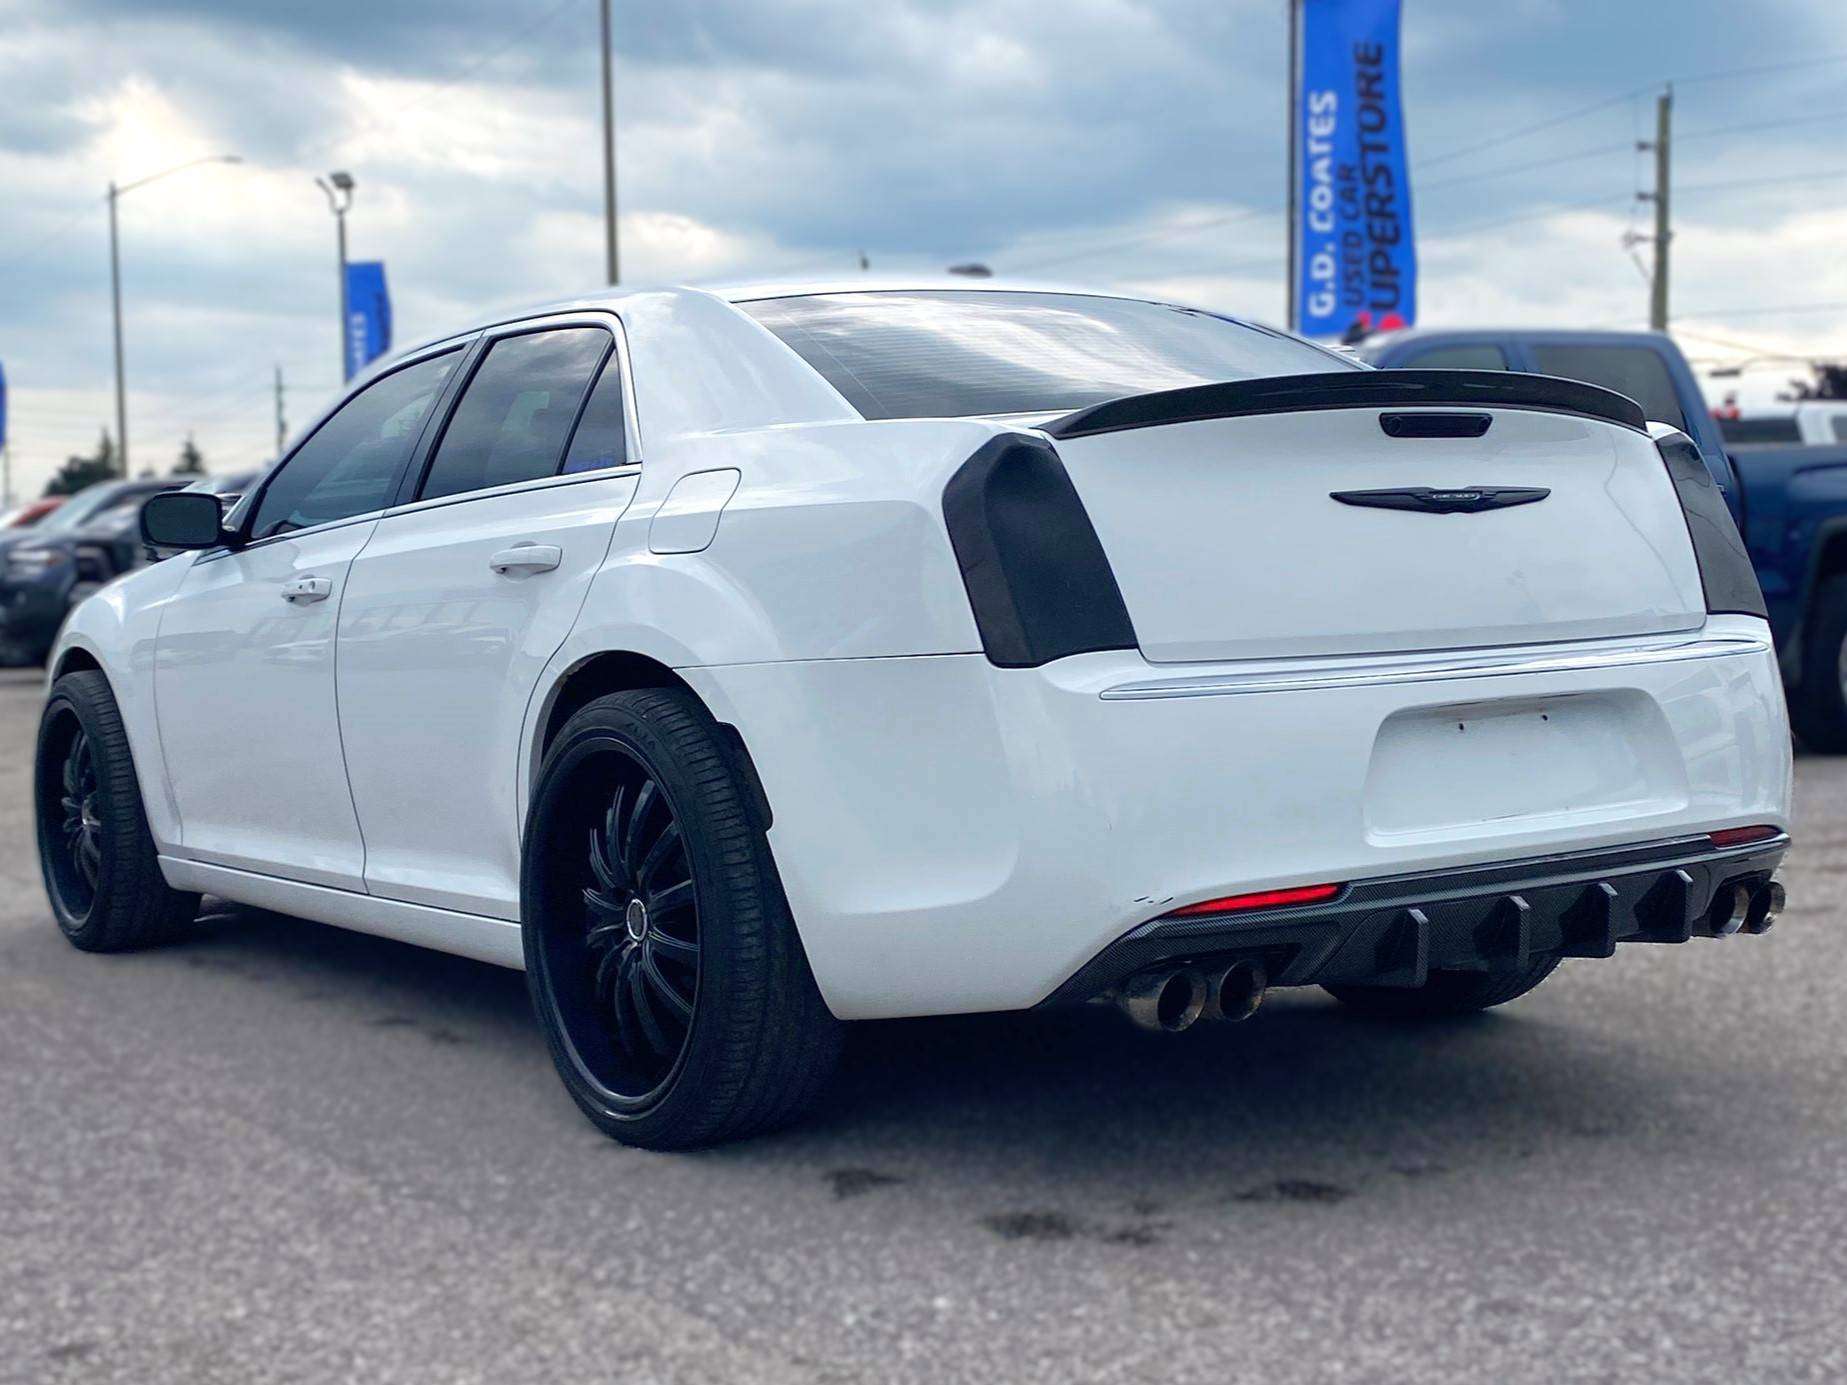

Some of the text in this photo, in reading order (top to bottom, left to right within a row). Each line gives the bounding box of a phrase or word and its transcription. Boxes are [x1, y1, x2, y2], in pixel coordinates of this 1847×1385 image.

[1307, 89, 1338, 318] G.D. COATES
[1337, 163, 1366, 307] USED CAR
[1354, 40, 1401, 316] UPERSTORE
